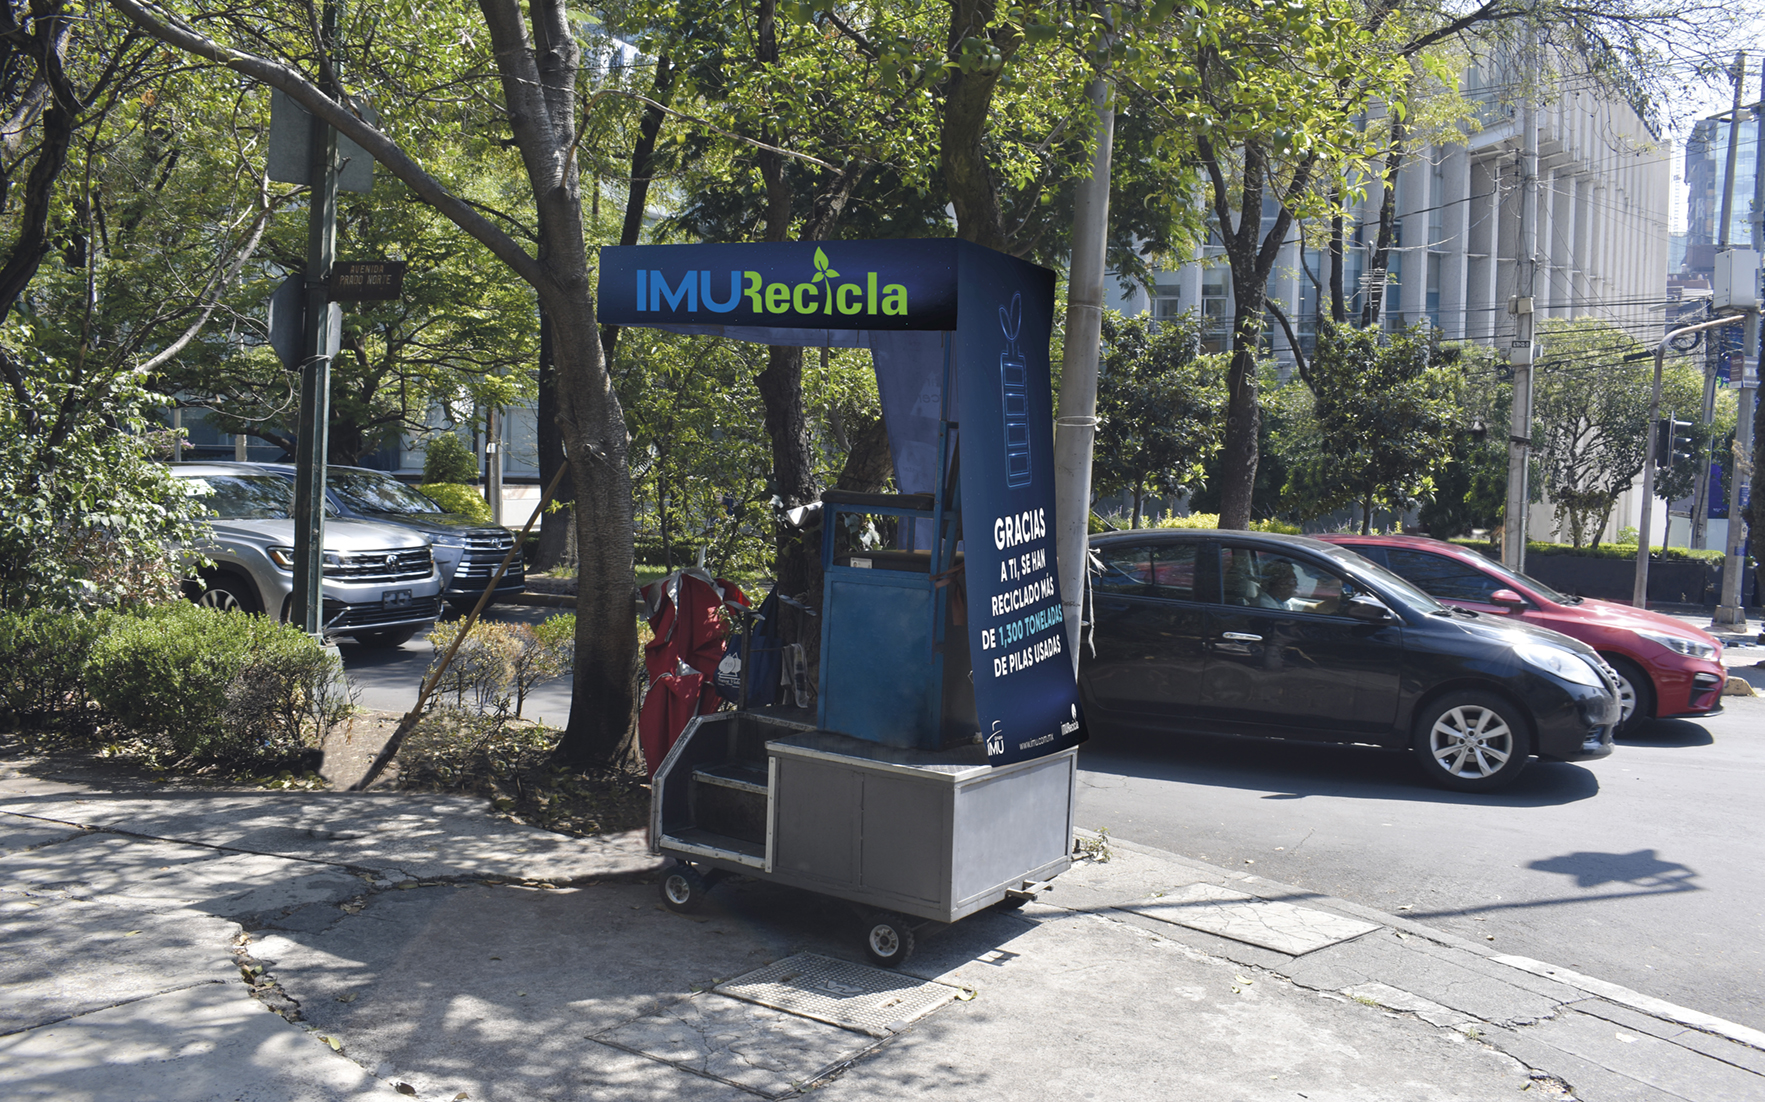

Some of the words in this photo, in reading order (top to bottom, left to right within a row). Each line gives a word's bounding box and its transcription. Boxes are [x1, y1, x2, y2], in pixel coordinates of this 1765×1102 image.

[339, 275, 363, 285] PRADO
[366, 274, 392, 285] NORTE
[350, 264, 384, 274] AVENIDA
[994, 507, 1046, 550] GRACIAS
[1000, 560, 1008, 582] A
[1021, 554, 1031, 574] SE
[1031, 547, 1046, 571] HAN
[991, 582, 1040, 617] RECICLADO
[1041, 572, 1055, 600] MÁS
[981, 628, 996, 650] DE
[998, 621, 1024, 649] 1,300
[1024, 603, 1063, 637] TONELADAS
[993, 655, 1008, 678] DE
[1008, 650, 1034, 673] PILAS
[1033, 634, 1062, 663] USADAS
[987, 740, 1004, 756] IMU
